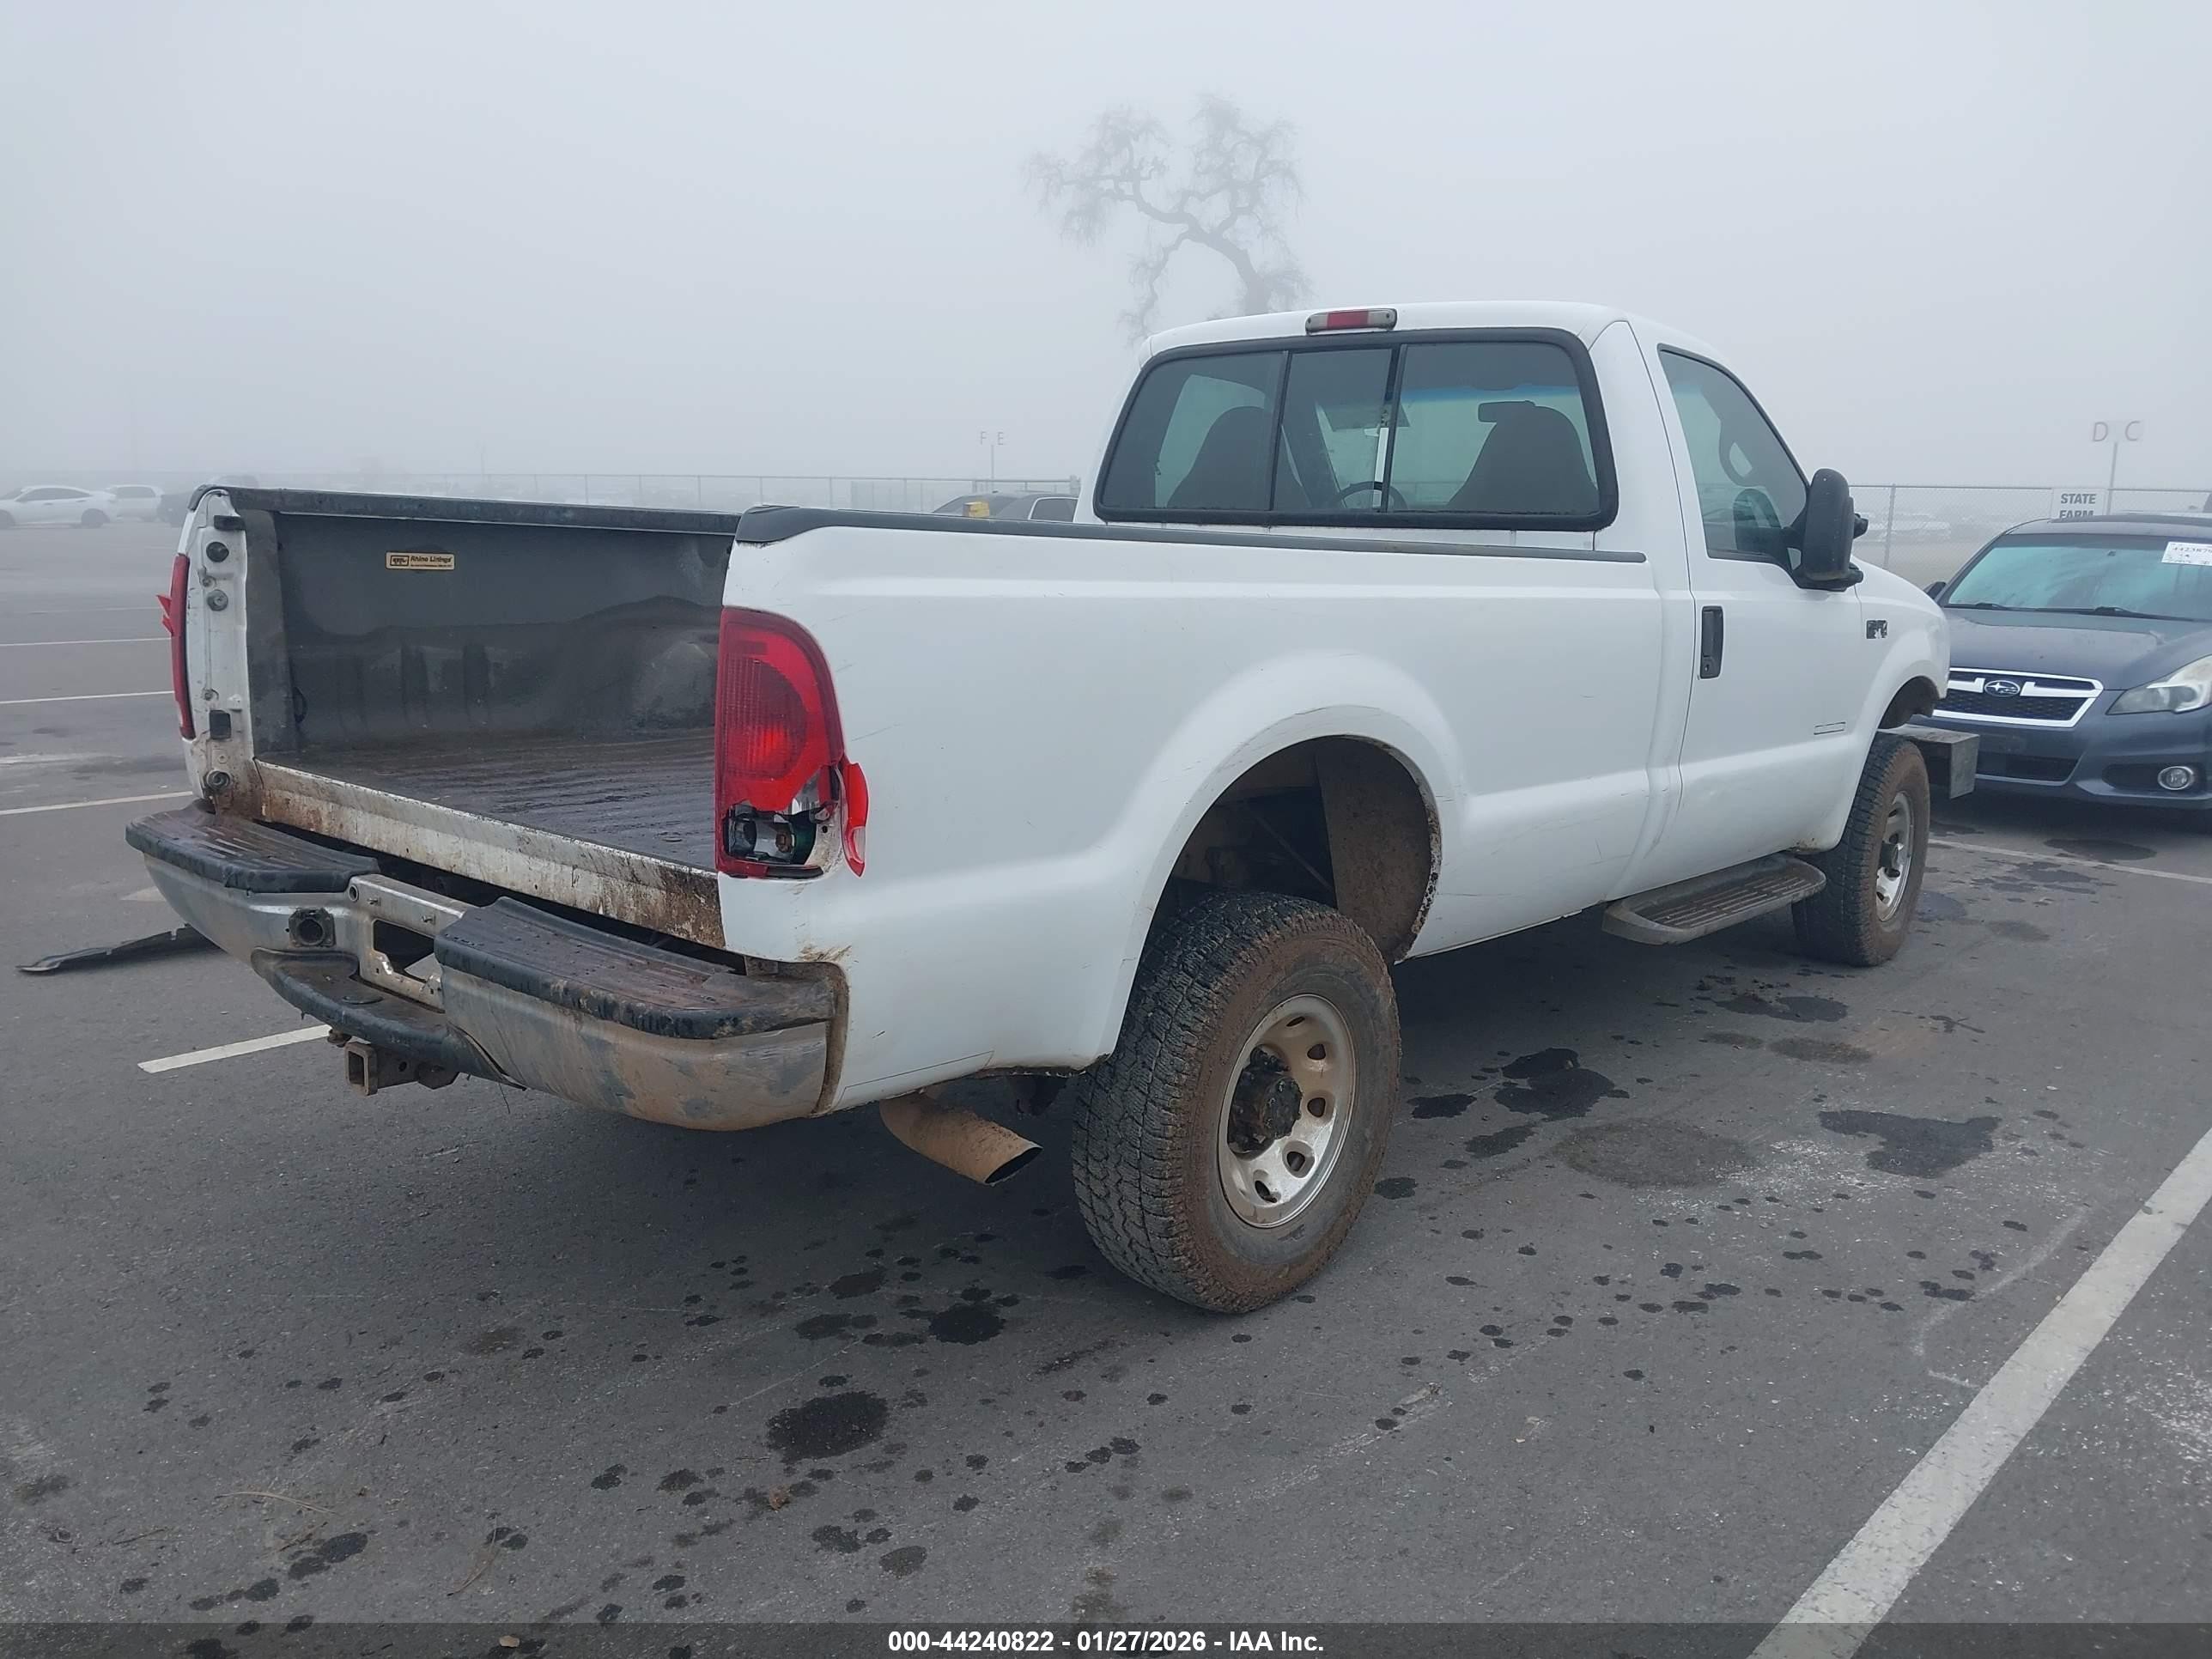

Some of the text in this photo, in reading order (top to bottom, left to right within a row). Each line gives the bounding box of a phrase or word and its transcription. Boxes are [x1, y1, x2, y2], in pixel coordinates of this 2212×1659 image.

[2093, 421, 2140, 441] D C
[2061, 494, 2096, 504] STATE
